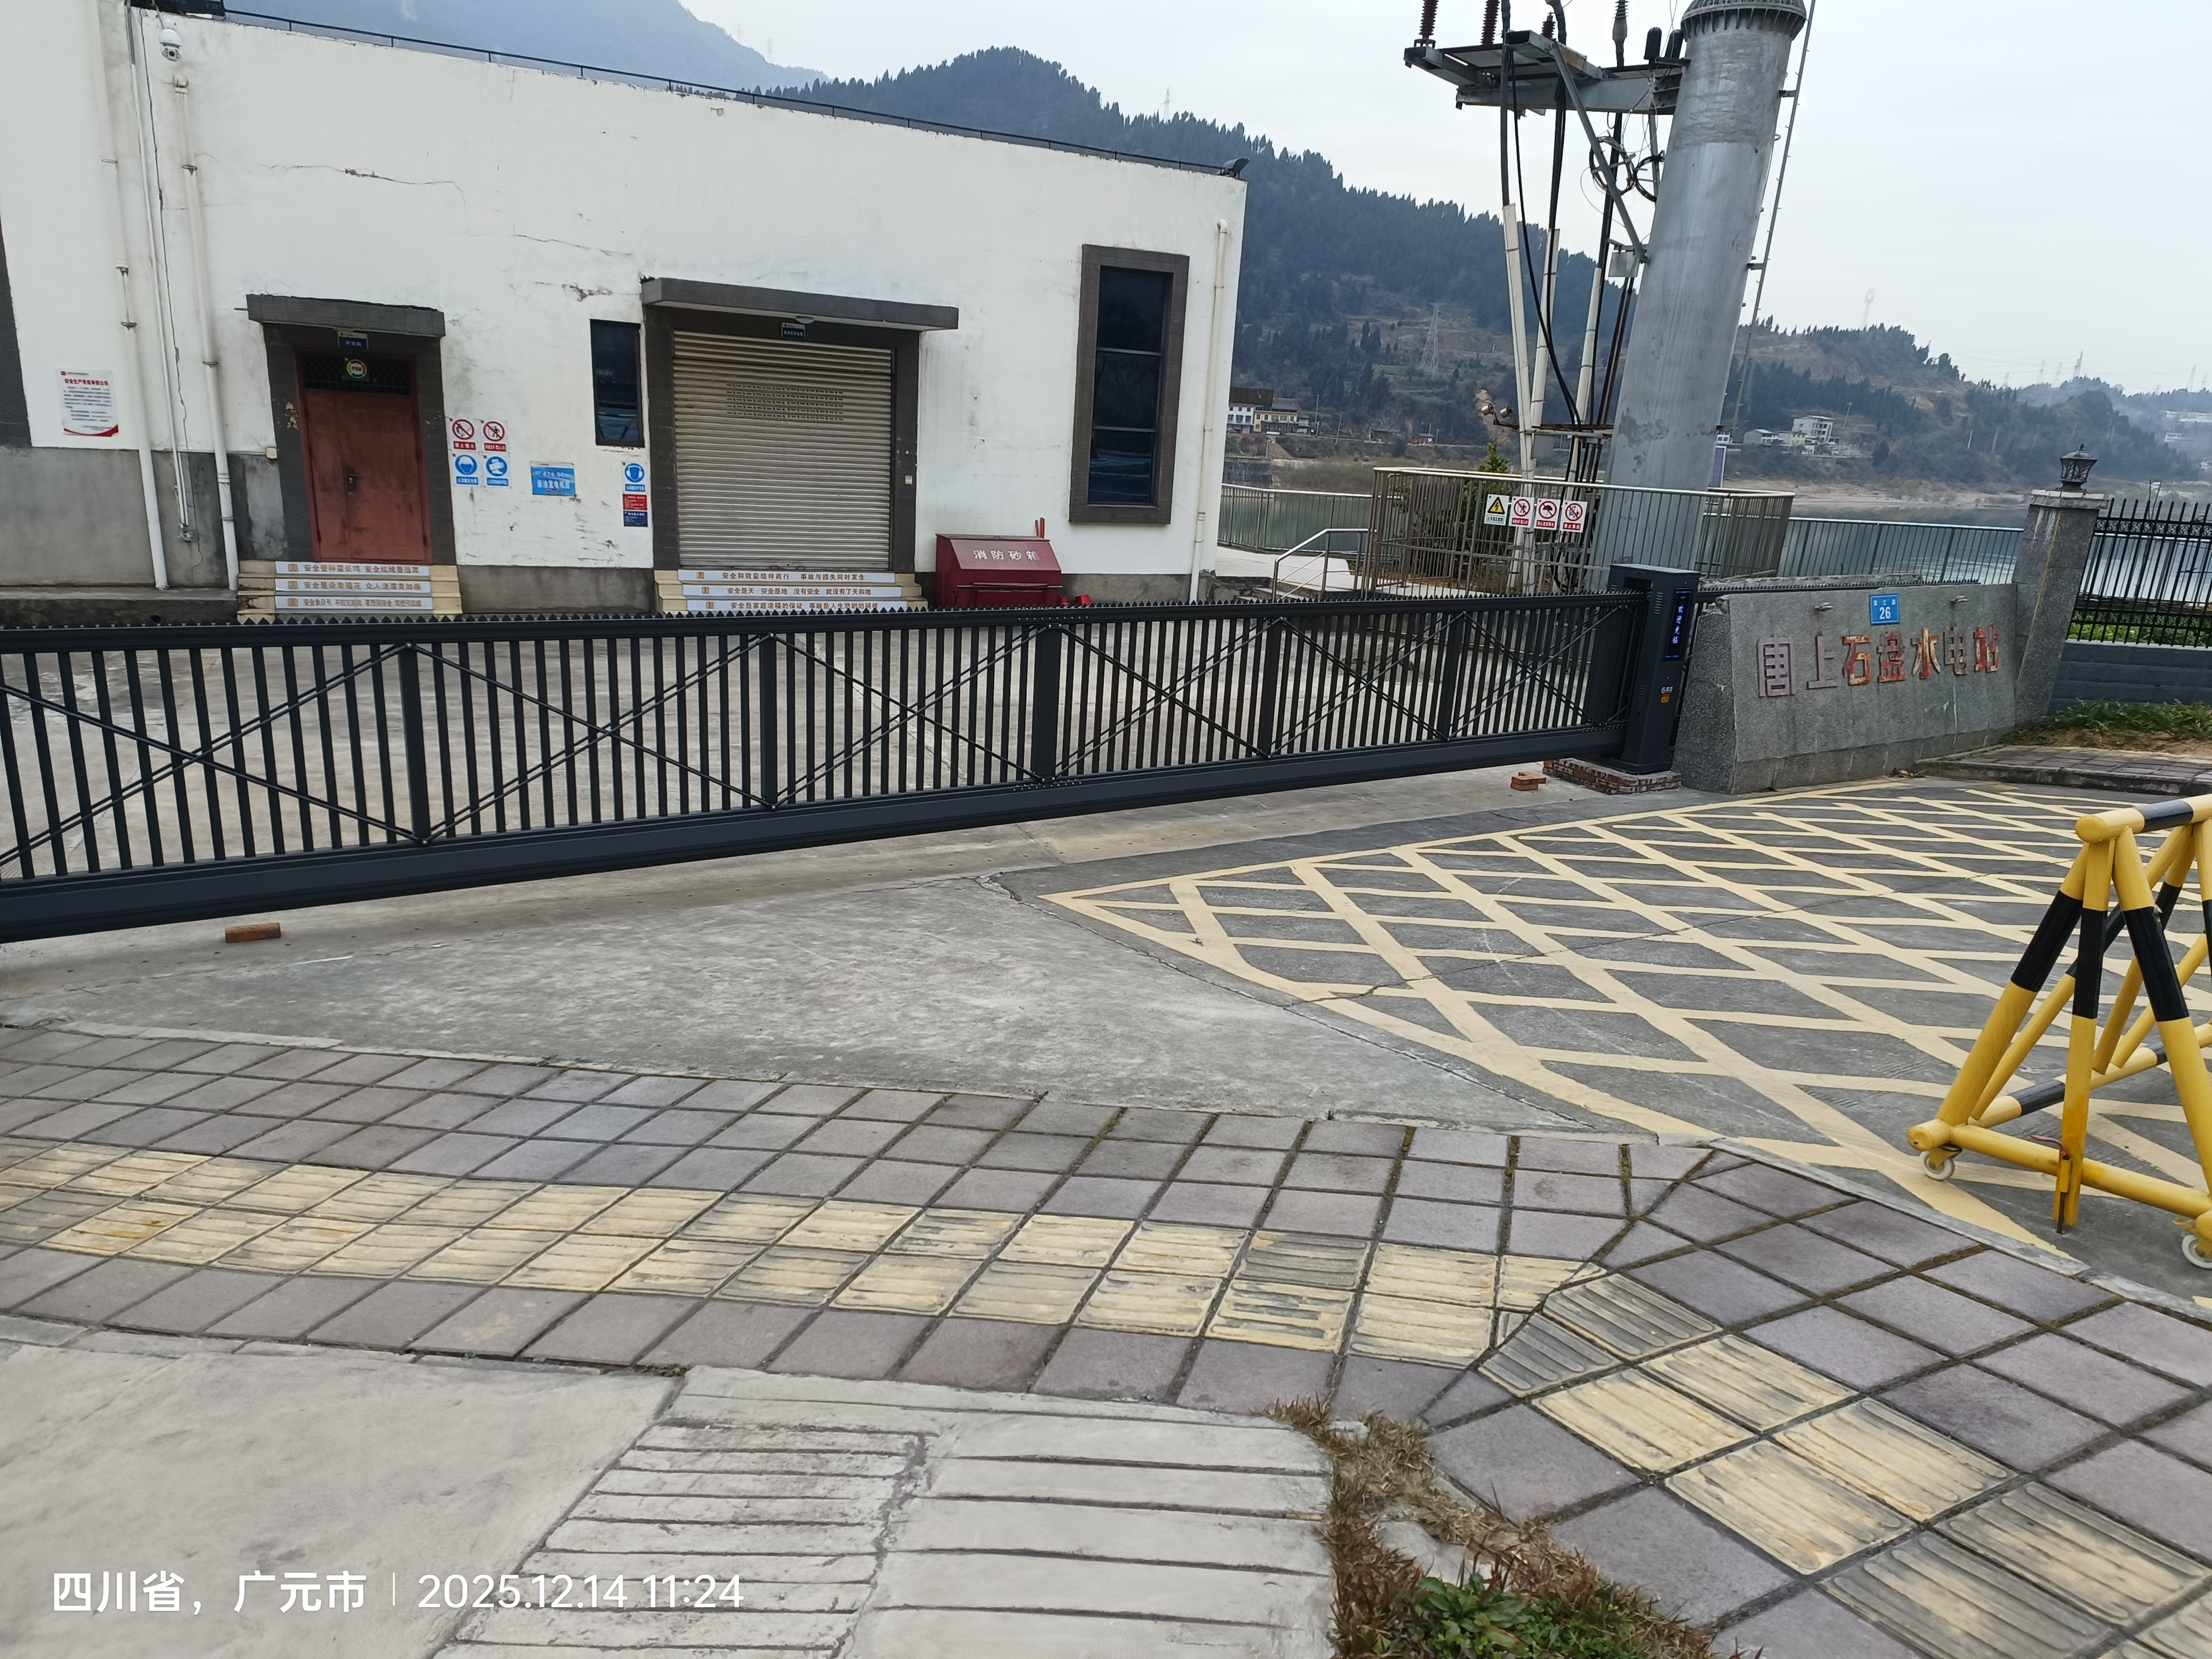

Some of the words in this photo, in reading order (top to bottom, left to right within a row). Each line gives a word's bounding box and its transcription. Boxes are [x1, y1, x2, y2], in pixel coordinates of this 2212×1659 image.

[973, 549, 1040, 561] 消防砂箱
[1879, 606, 1891, 619] 26
[1672, 604, 1684, 644] 欢迎光临
